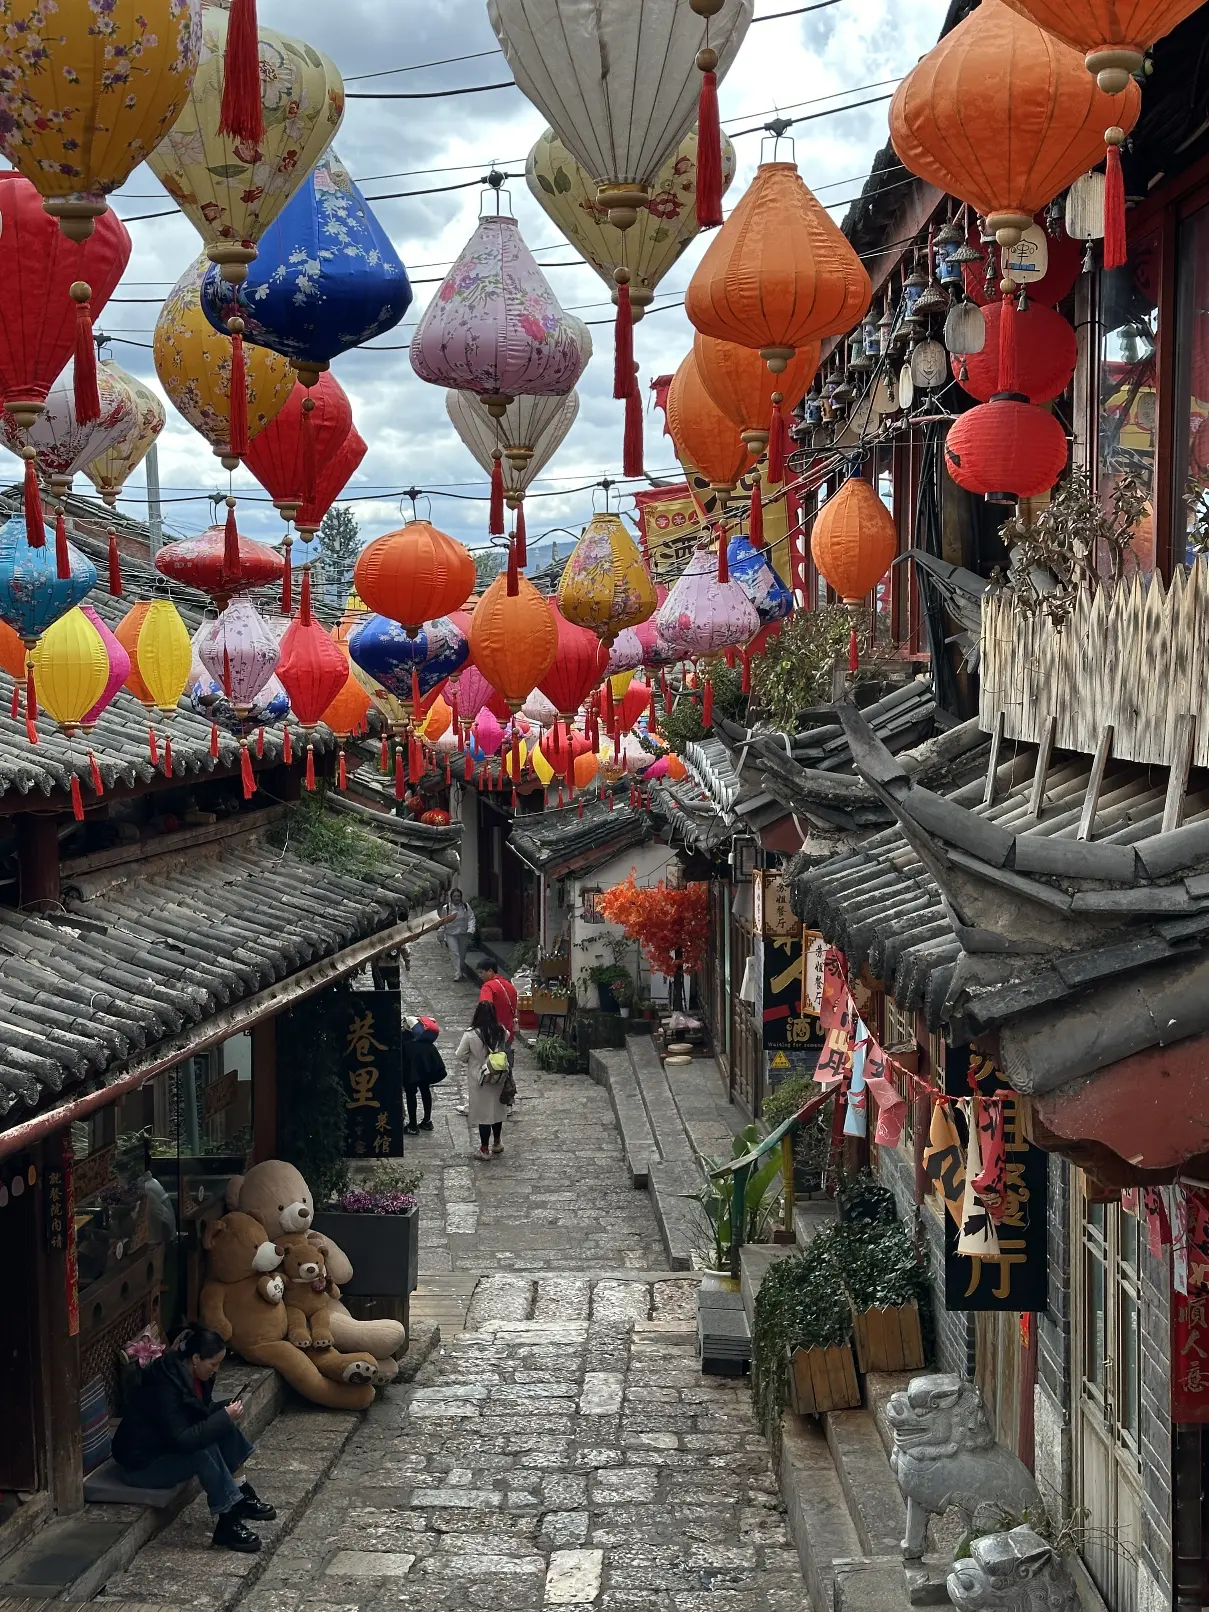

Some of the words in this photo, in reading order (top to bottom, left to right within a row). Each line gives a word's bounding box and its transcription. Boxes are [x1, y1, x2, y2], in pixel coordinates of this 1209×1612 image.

[775, 883, 787, 929] 苏姐餐厅
[813, 944, 824, 1006] 苏姐餐厅
[343, 1010, 388, 1109] 巷里
[373, 1111, 392, 1153] 菜馆
